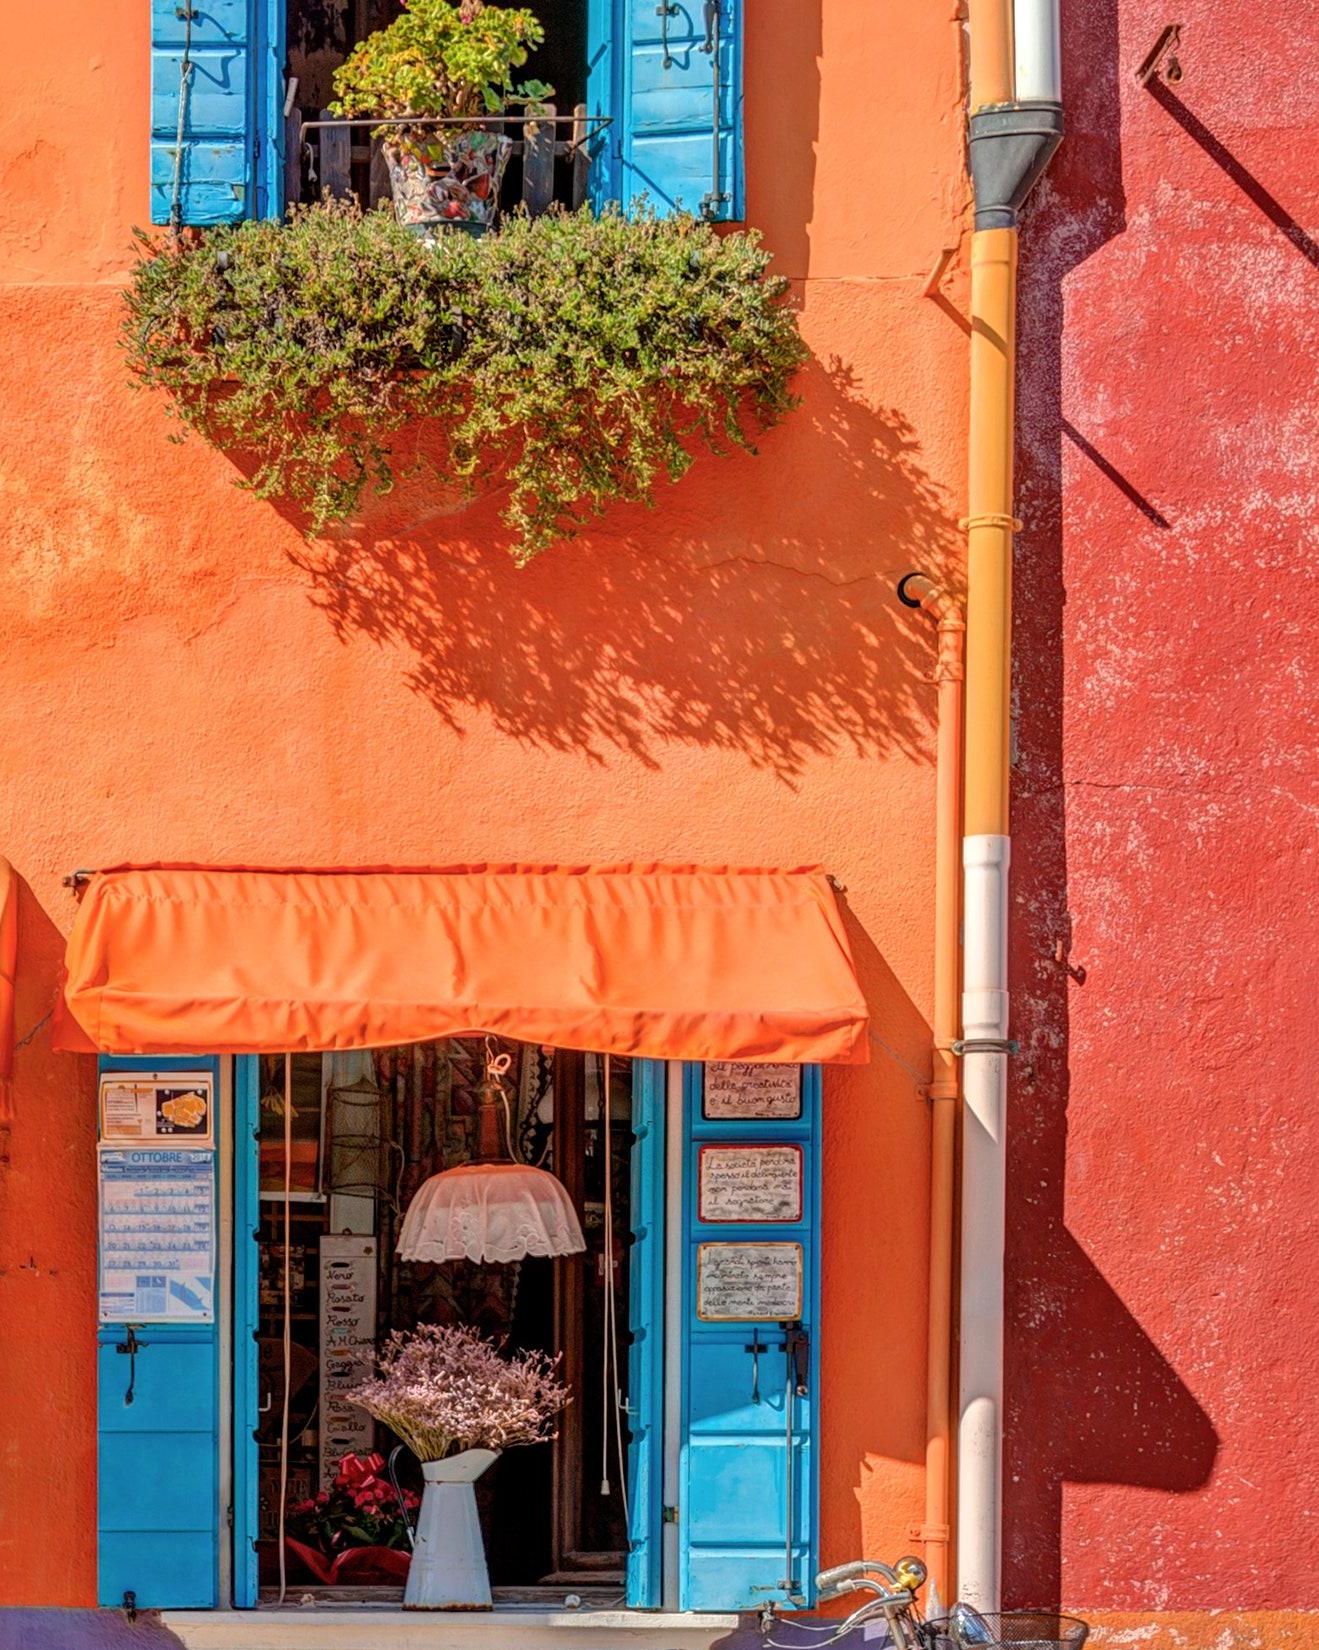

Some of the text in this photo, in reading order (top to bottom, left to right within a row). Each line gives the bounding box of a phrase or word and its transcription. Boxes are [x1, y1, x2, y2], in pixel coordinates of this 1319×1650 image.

[709, 1077, 737, 1091] della
[721, 1094, 733, 1105] il
[737, 1093, 765, 1106] buon
[766, 1092, 796, 1109] gusto
[131, 1151, 182, 1163] OTTOBRE
[705, 1155, 722, 1170] La
[710, 1172, 740, 1183] spesso
[326, 1270, 355, 1280] Nero
[326, 1291, 366, 1304] Rosato
[326, 1314, 361, 1327] Rosso
[326, 1400, 355, 1413] Rosa
[326, 1421, 367, 1434] Giallo
